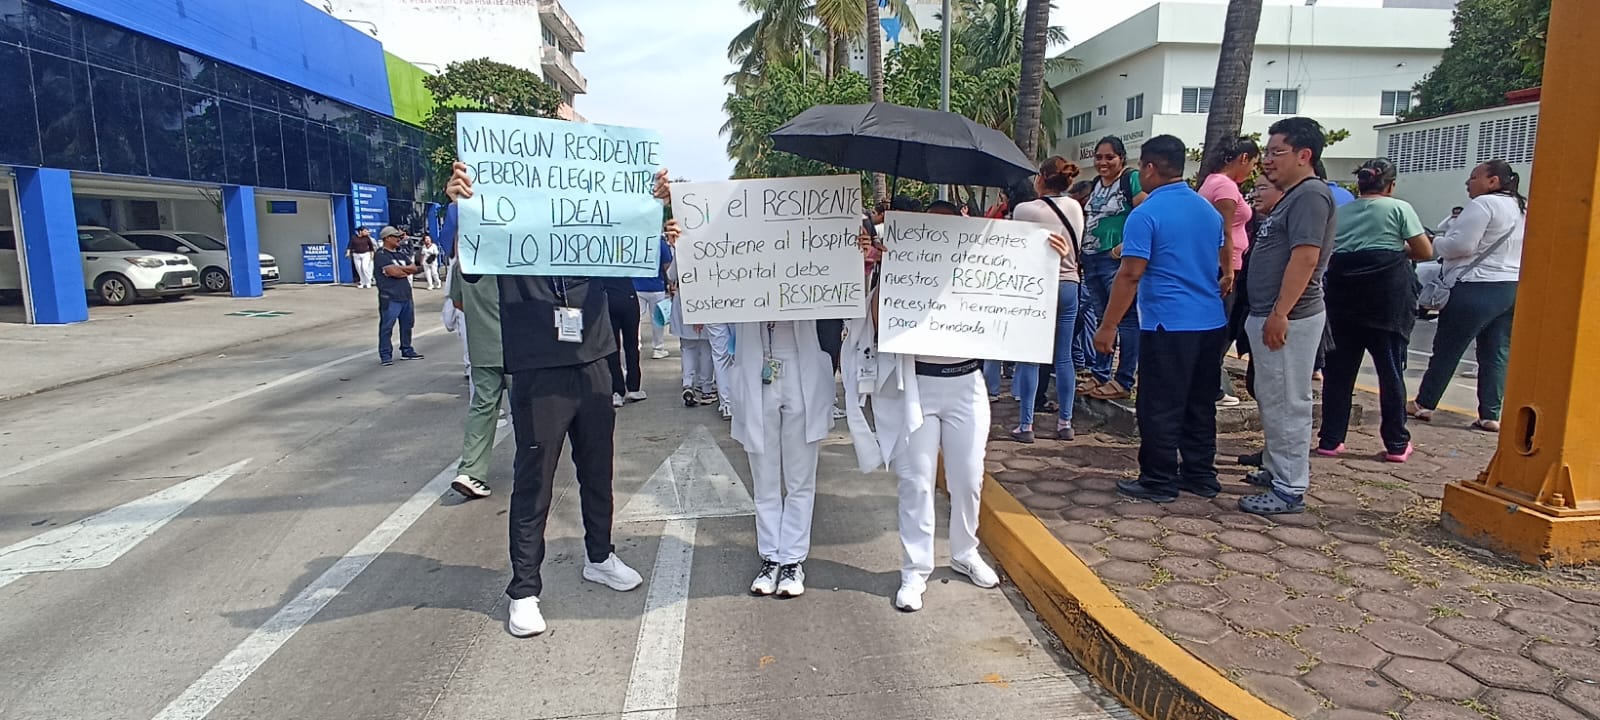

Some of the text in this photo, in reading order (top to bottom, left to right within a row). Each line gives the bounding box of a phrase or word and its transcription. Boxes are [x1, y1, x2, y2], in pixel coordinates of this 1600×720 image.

[462, 126, 660, 166] NINGUN RESIDENTE
[548, 166, 606, 194] ELEGIR
[480, 194, 620, 225] LO IDEAL
[682, 187, 860, 230] Si el RESIDENTE
[774, 230, 790, 250] al
[887, 220, 1027, 249] Nuestros pacientes
[464, 233, 657, 266] Y LO DISPONIBLE
[888, 249, 941, 263] necitan
[681, 261, 830, 287] el Hospital debe
[885, 267, 1045, 295] nuestros RESIDENTES
[686, 283, 861, 313] sostener al RESIDENTE
[884, 297, 1047, 319] necesitan herramientas
[888, 316, 917, 329] para
